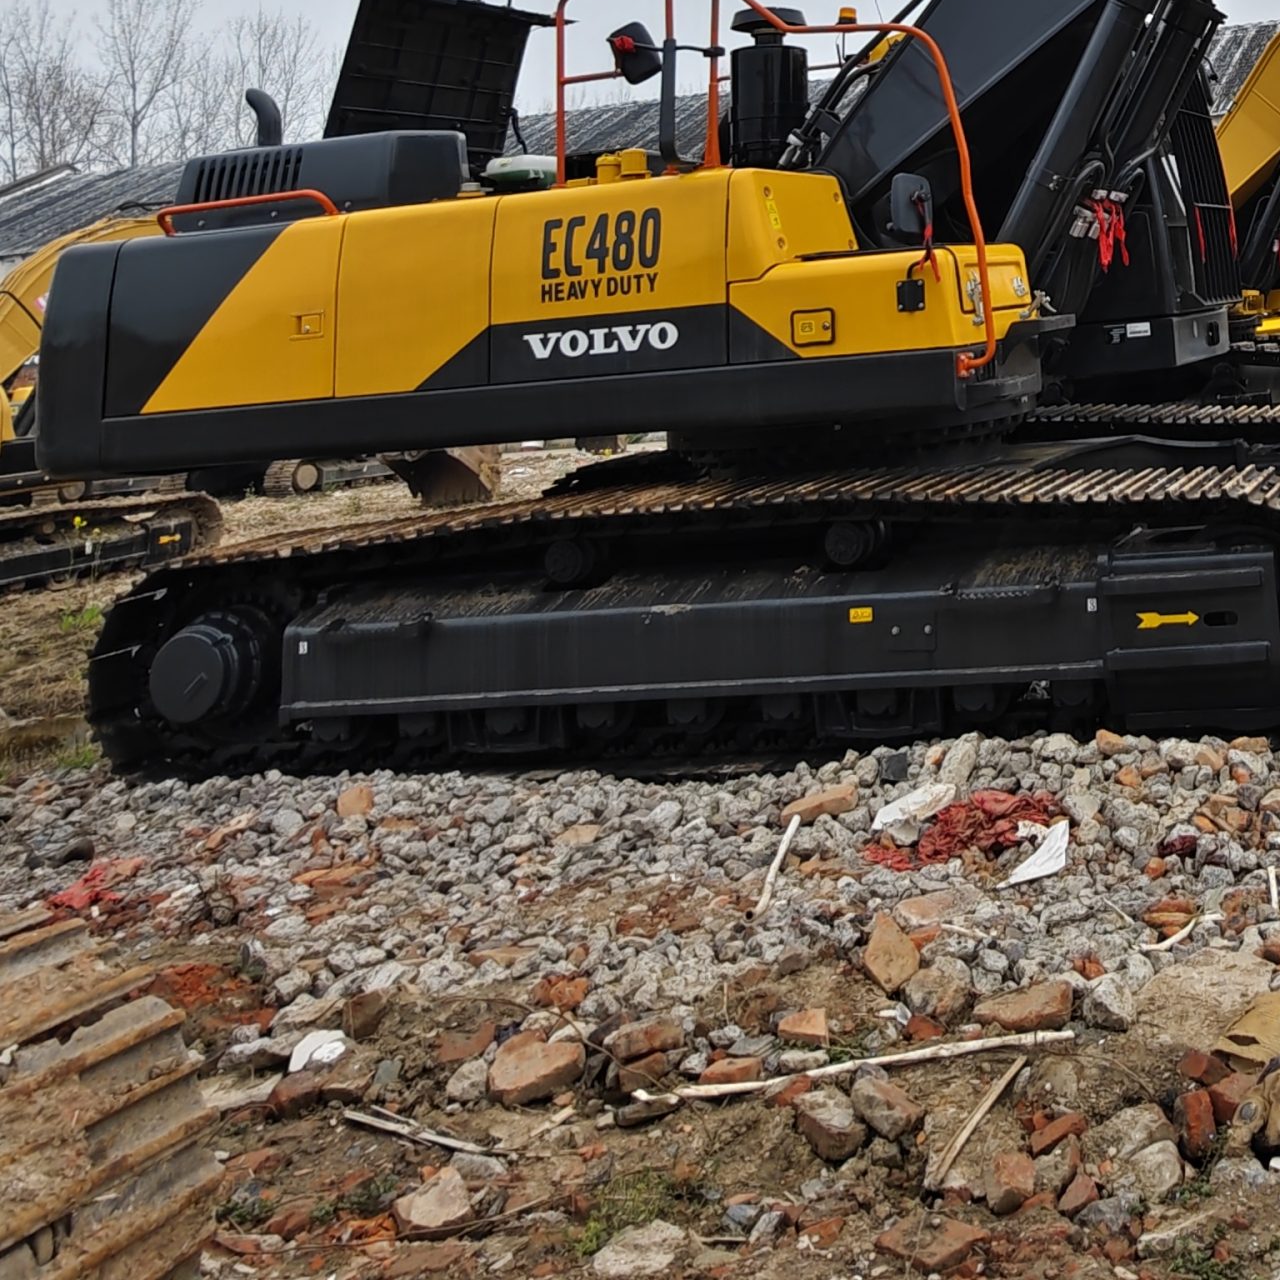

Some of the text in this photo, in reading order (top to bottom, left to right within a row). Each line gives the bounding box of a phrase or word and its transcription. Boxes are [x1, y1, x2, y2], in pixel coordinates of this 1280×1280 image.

[541, 207, 662, 280] EC480
[541, 272, 659, 303] HEAVY DUTY
[522, 321, 679, 359] VOLVO
